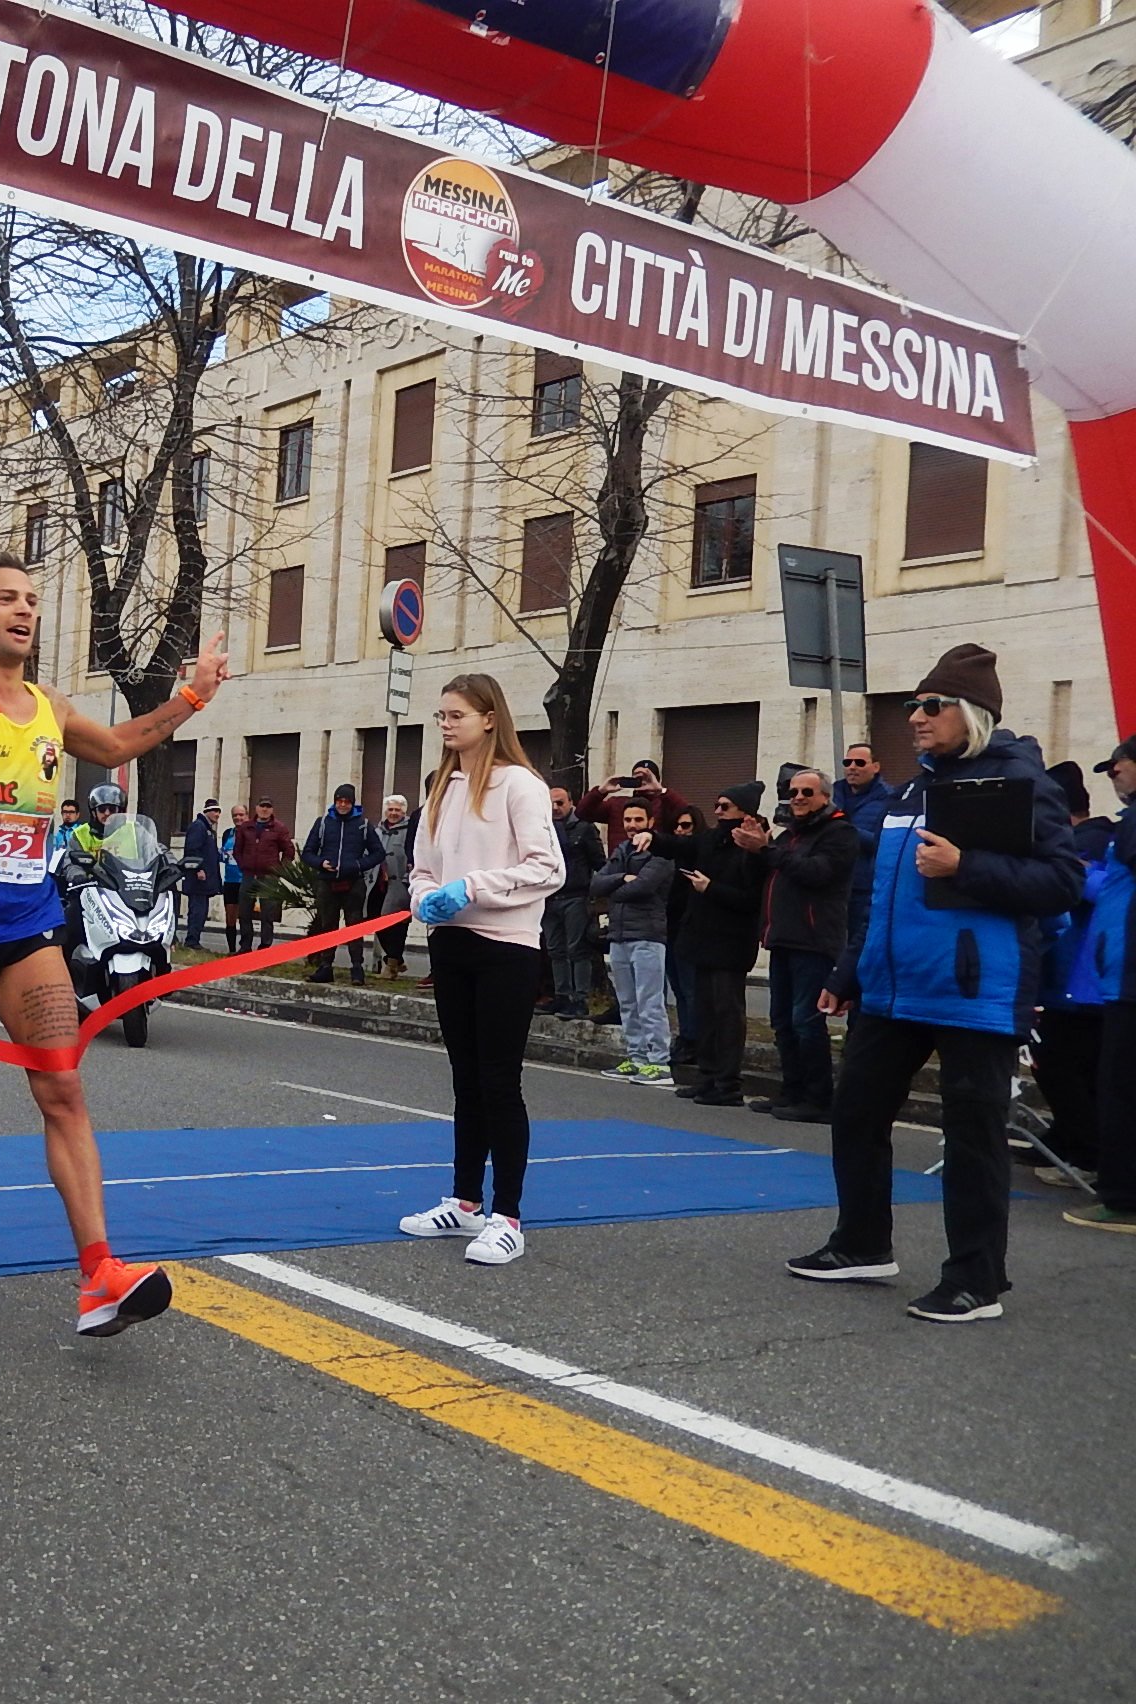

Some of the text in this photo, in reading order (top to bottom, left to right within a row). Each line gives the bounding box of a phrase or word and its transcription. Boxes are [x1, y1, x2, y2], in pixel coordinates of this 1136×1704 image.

[173, 104, 363, 249] DELLA
[414, 193, 512, 234] MARATHON
[423, 174, 508, 217] MESSINA
[424, 262, 484, 287] MARATONA
[499, 249, 534, 268] run to
[426, 280, 478, 303] MESSINA
[492, 265, 531, 297] Me
[570, 231, 1005, 423] CITTÀ DI MESSINA
